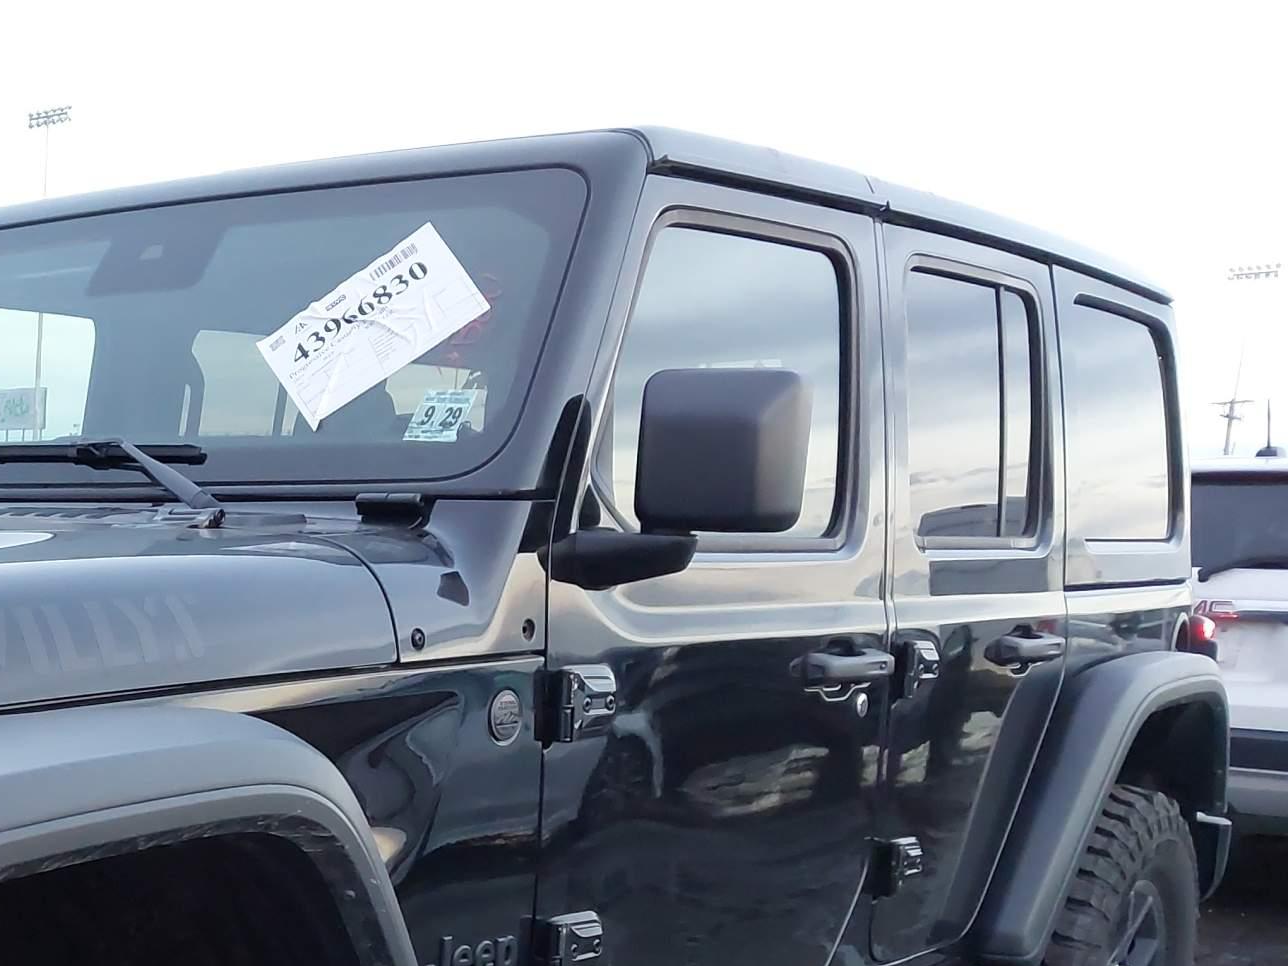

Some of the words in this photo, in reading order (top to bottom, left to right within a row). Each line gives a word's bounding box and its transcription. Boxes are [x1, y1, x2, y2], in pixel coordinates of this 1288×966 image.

[293, 261, 428, 363] 43966830
[420, 405, 436, 425] 9
[438, 406, 463, 428] 29
